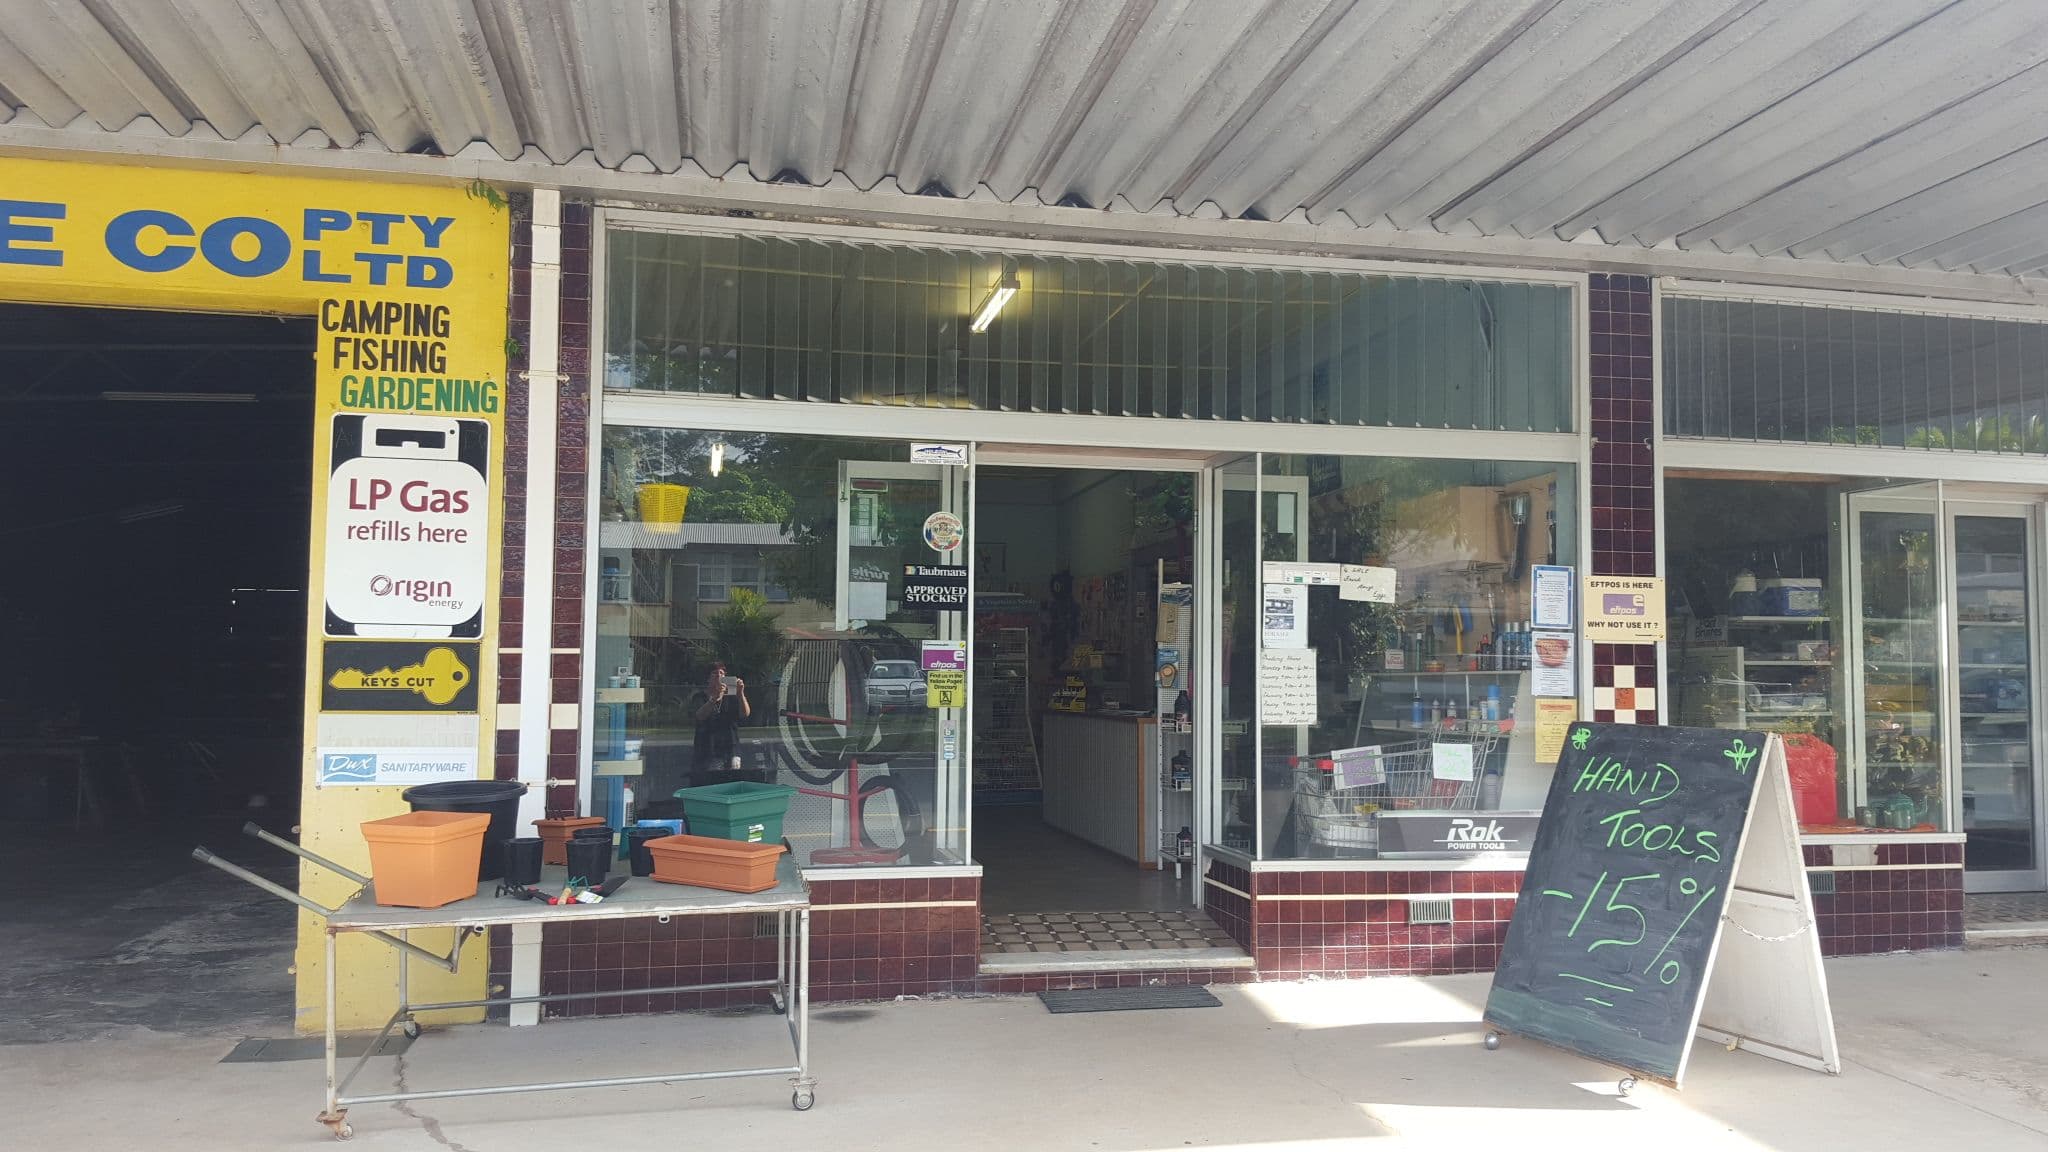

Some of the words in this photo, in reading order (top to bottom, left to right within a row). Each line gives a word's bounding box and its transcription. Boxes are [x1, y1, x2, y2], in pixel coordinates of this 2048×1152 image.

[303, 208, 456, 248] PTY
[105, 209, 291, 278] CO
[302, 250, 453, 289] LTD
[322, 300, 450, 338] CAMPING
[333, 337, 446, 374] FISHING
[340, 375, 498, 413] GARDENING
[349, 478, 392, 510] LP
[400, 480, 469, 513] Gas
[348, 520, 411, 541] refills
[418, 522, 467, 543] here
[917, 566, 967, 577] Taubmans
[370, 575, 452, 602] Origin
[905, 585, 967, 595] APPROVED
[906, 594, 965, 603] STOCKIST
[429, 599, 464, 609] energy
[361, 677, 399, 687] KEYS
[406, 677, 435, 687] CUT
[330, 755, 373, 771] Dux
[381, 763, 467, 773] SANITARYWARE
[1573, 757, 1680, 804] HAND
[1447, 818, 1504, 841] Rok
[1600, 809, 1721, 862] TOOLS
[1447, 842, 1476, 850] POWER
[1478, 842, 1505, 850] TOOLS
